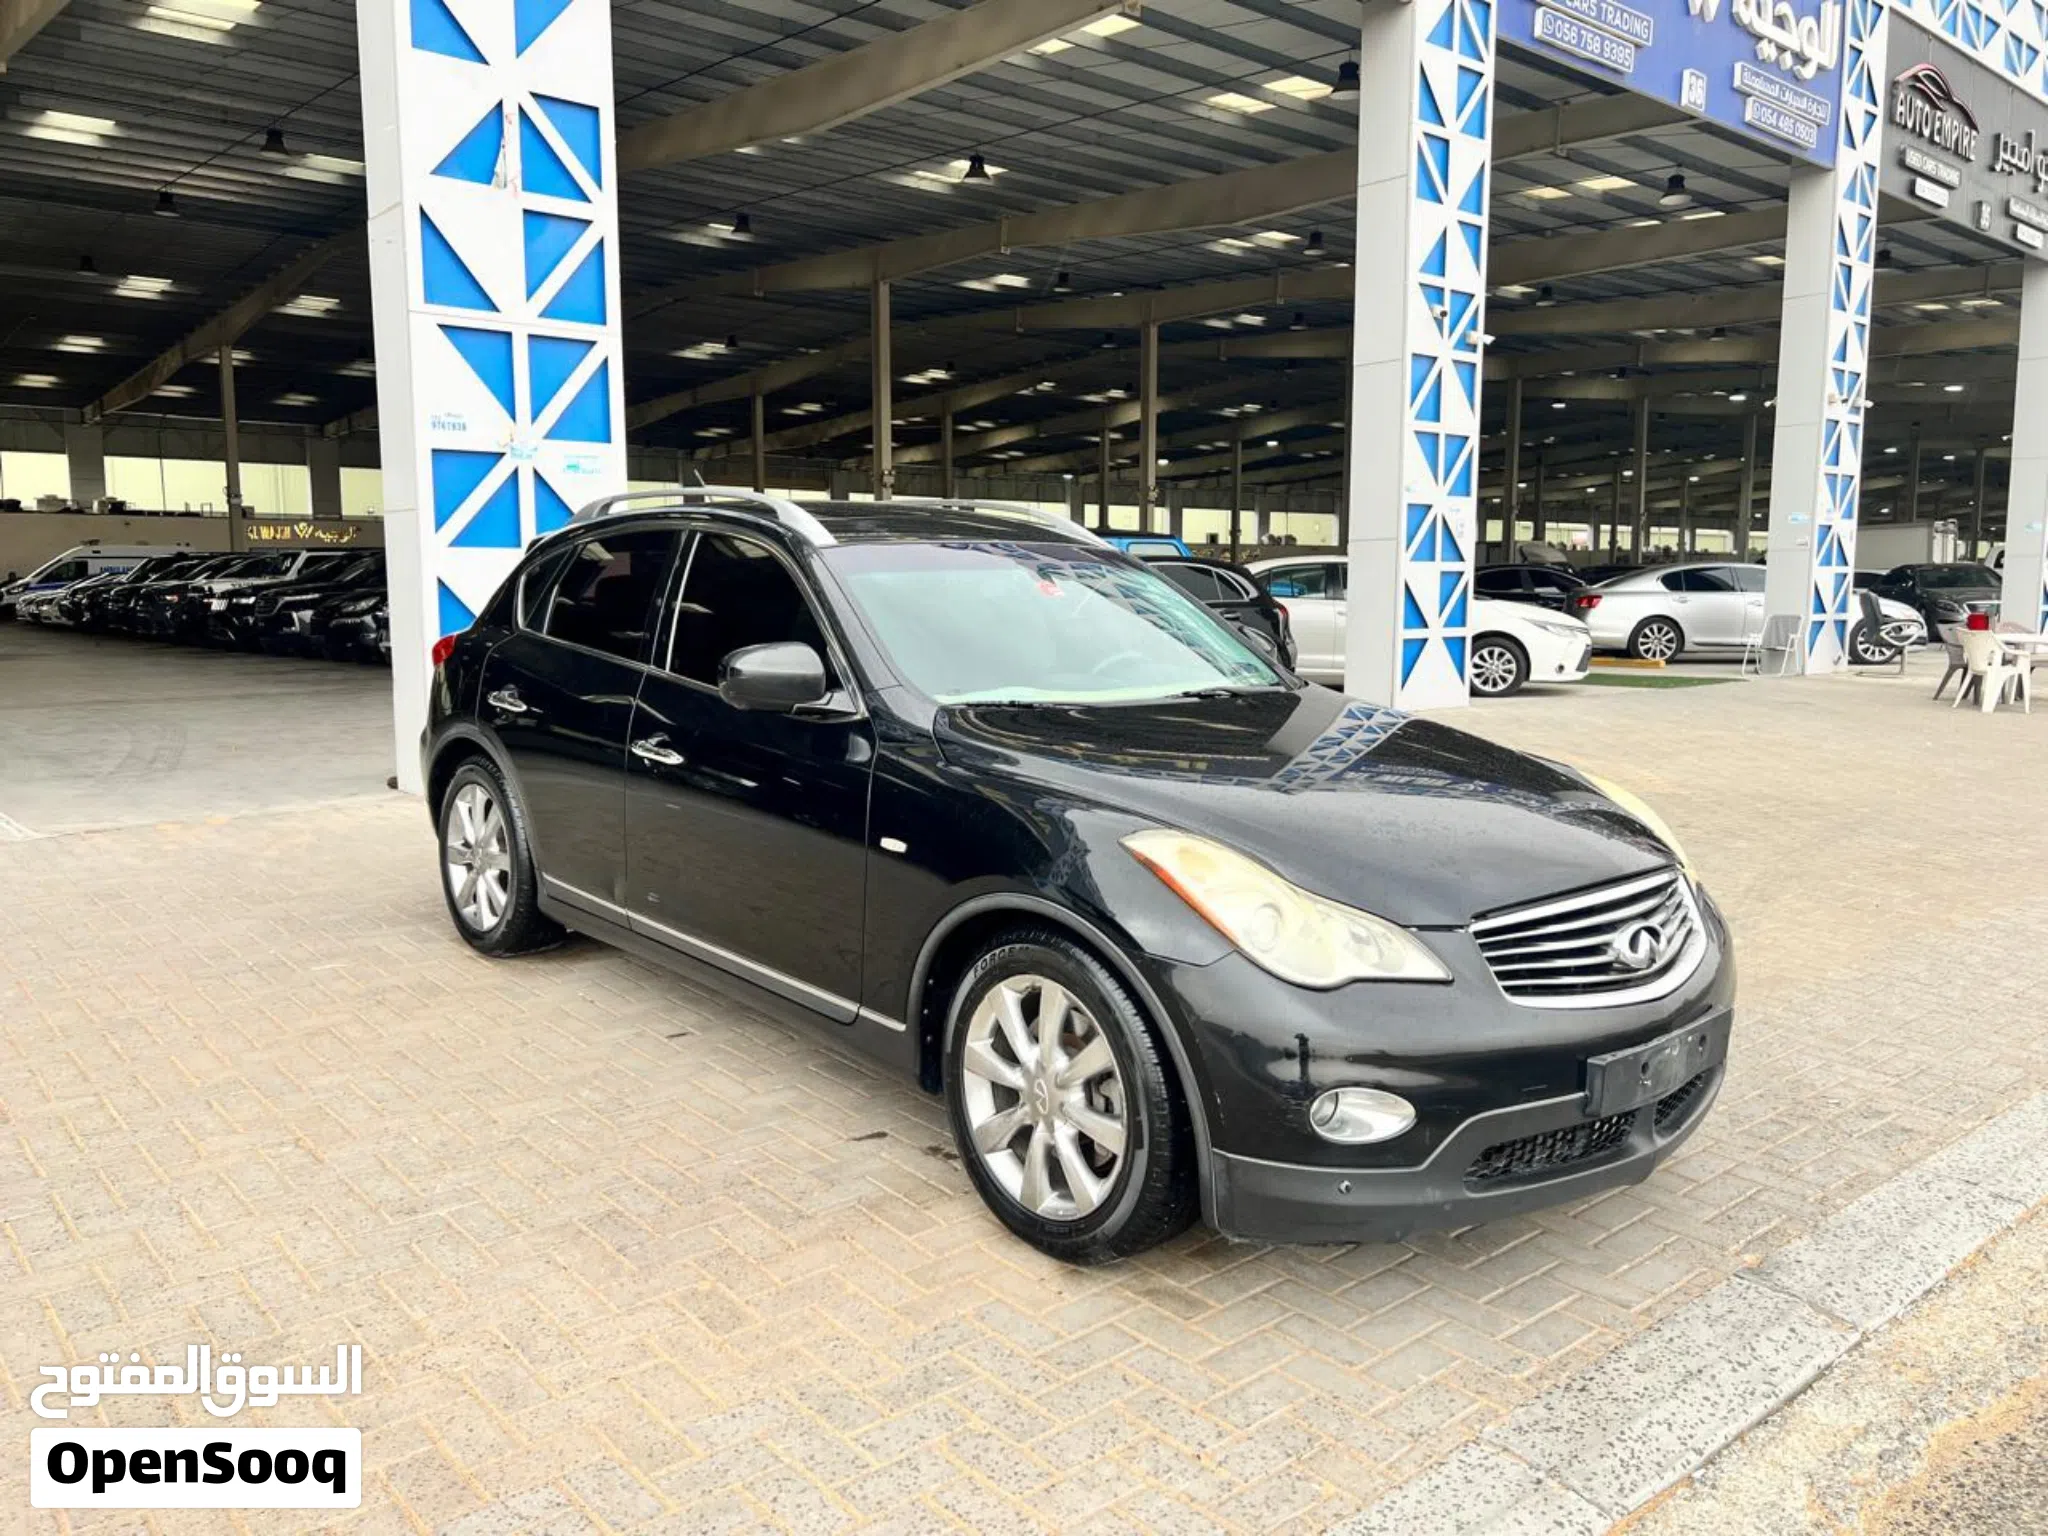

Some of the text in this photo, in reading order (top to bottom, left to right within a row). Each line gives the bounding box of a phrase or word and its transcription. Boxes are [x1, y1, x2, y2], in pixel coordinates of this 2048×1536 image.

[1555, 20, 1632, 67] 056 758 9395
[1600, 2, 1649, 39] TRADING
[1896, 92, 1977, 161] AUTO EMPIRE
